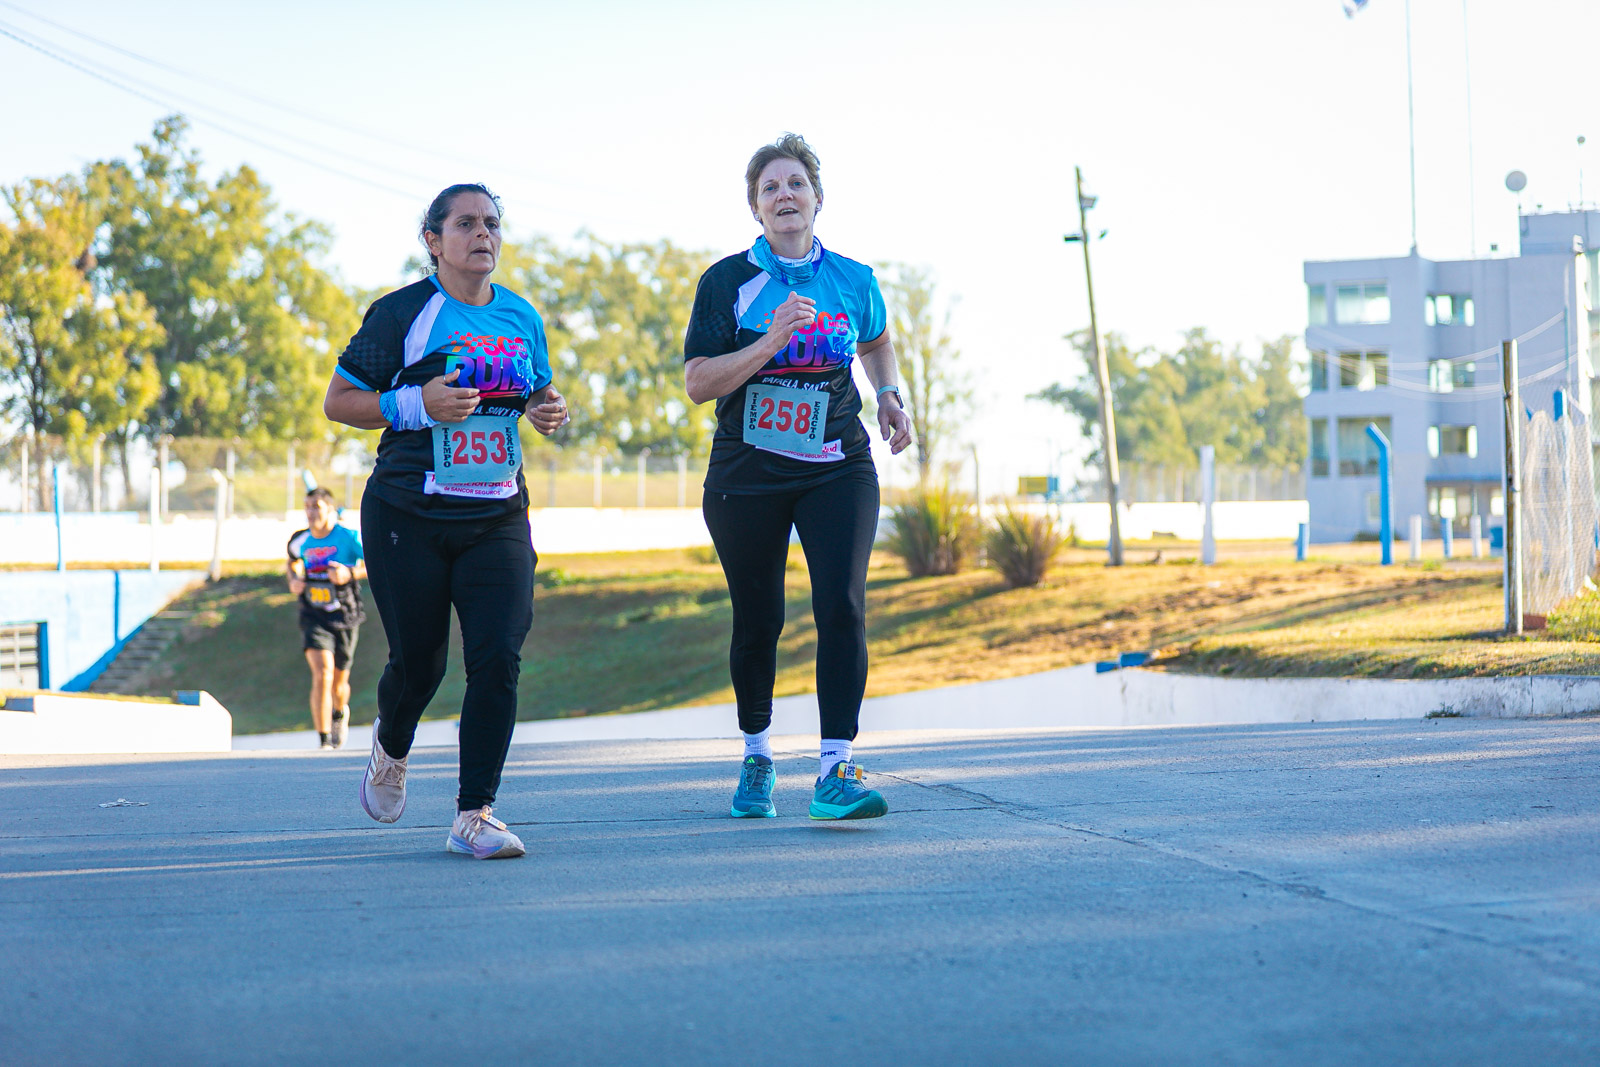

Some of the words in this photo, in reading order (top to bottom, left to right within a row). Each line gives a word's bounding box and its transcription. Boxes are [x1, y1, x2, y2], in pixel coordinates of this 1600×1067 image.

[445, 356, 525, 391] RUN
[749, 392, 759, 430] TIEMPO
[758, 397, 811, 434] 258
[809, 401, 820, 440] EXACTO
[442, 427, 451, 468] TIEMPO
[452, 430, 507, 464] 253
[505, 427, 515, 466] EXACTO
[450, 486, 474, 494] SANCOR
